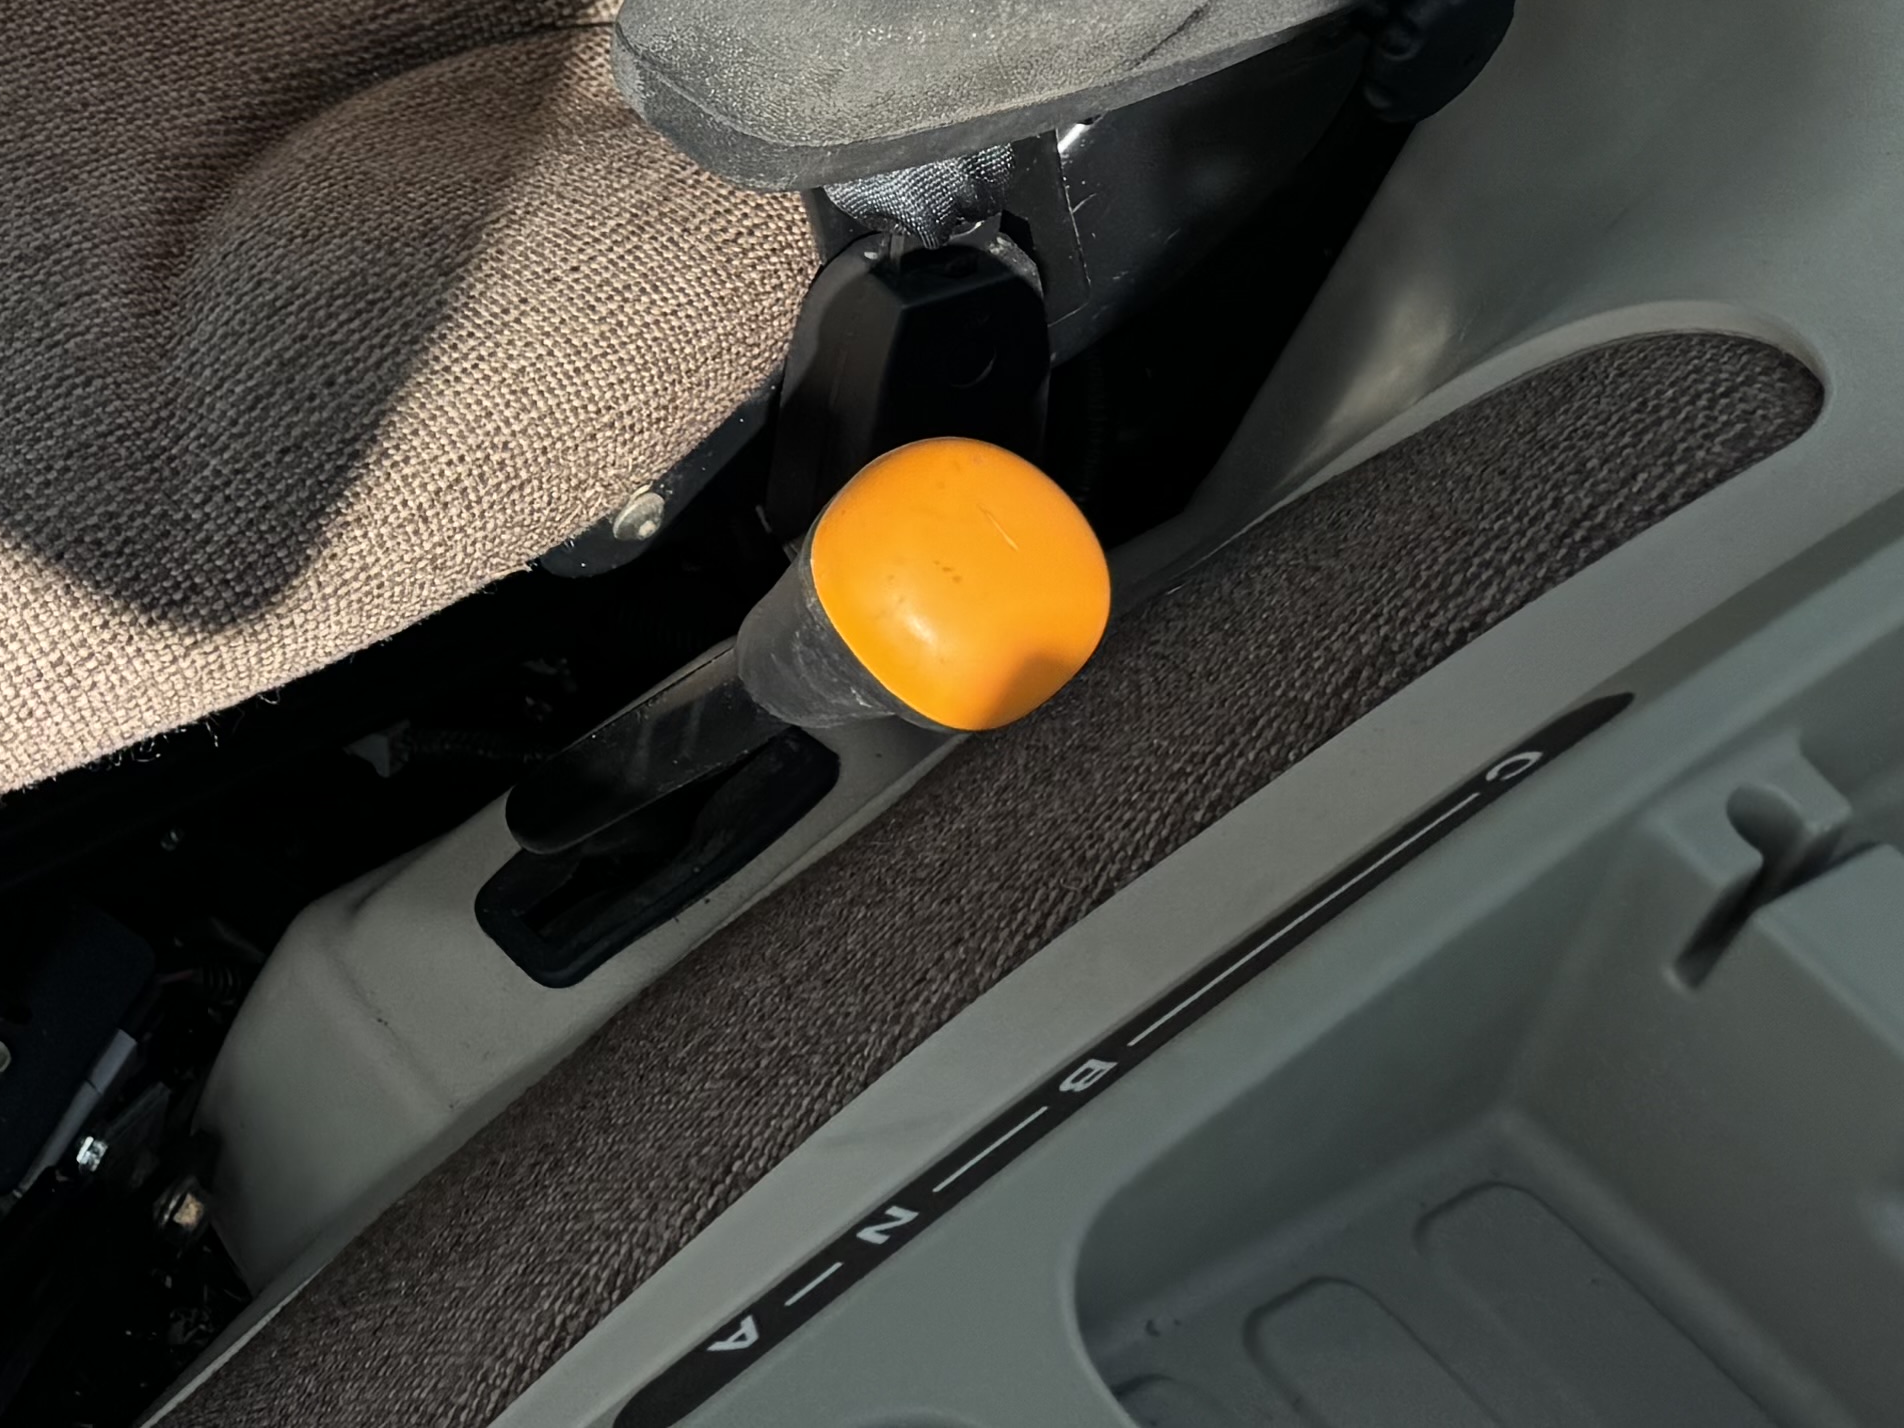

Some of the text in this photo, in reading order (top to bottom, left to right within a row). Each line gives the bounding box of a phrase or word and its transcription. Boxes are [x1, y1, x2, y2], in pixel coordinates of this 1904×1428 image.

[706, 751, 1544, 1353] C B N A
